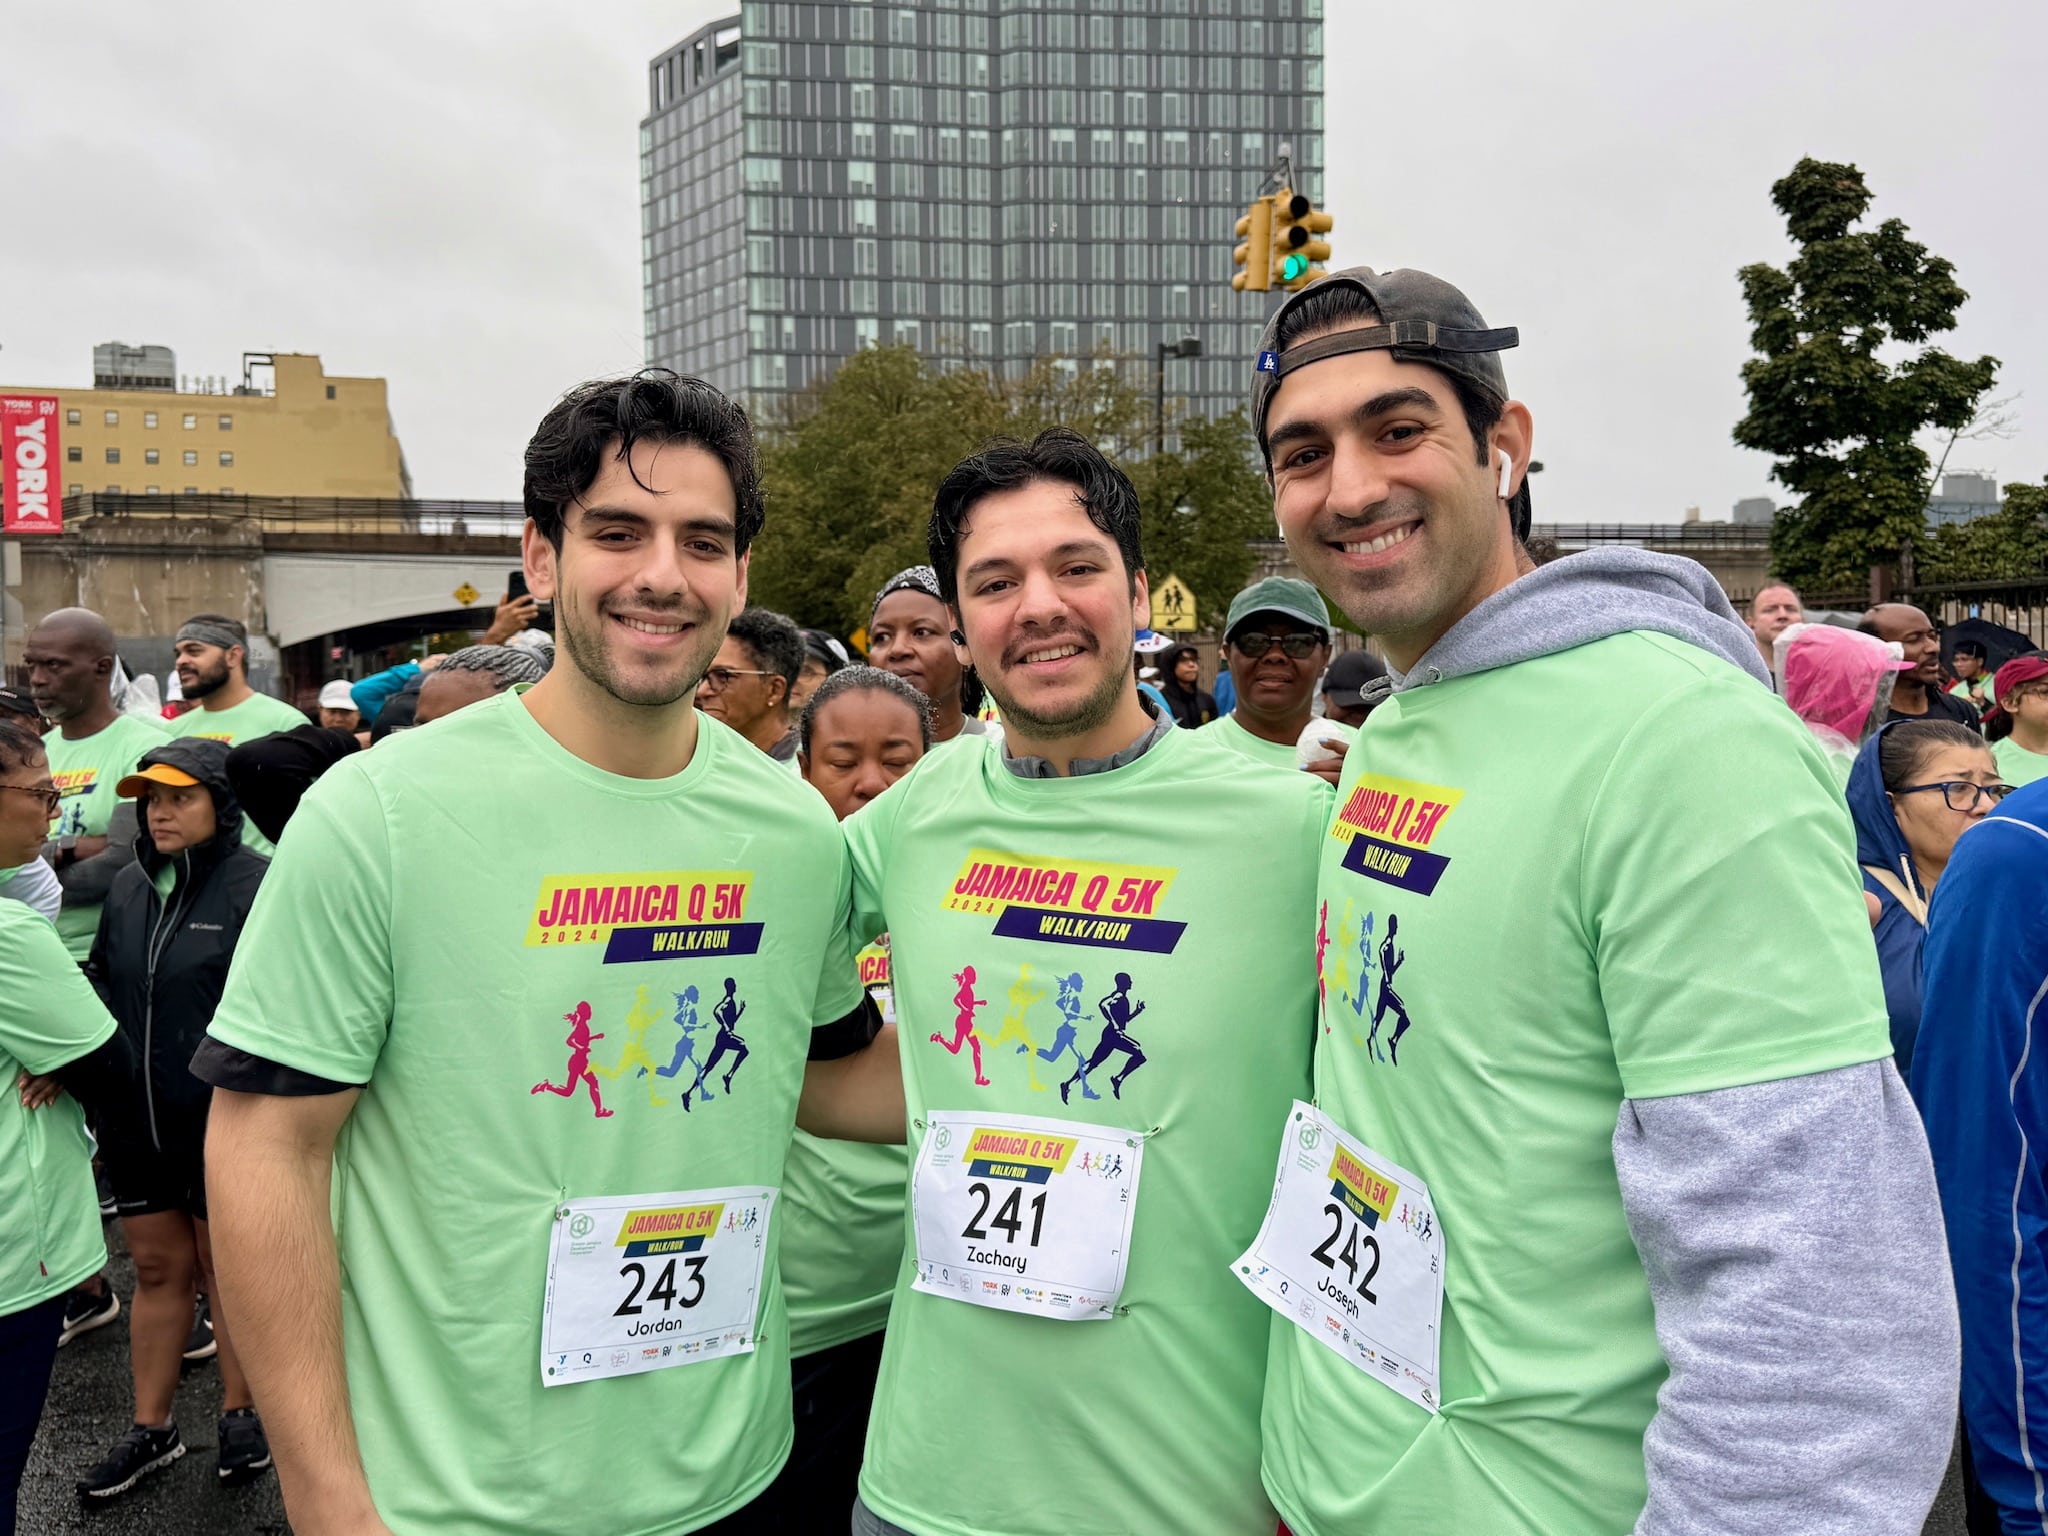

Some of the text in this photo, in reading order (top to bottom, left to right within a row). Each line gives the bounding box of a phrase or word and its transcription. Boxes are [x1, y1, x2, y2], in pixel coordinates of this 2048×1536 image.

[15, 416, 49, 519] YORK
[1340, 786, 1450, 845] JAMAICA Q 5K
[1363, 844, 1412, 878] WALK/RUN
[954, 862, 1163, 915] JAMAICA Q 5K
[538, 883, 746, 927] JAMAICA Q 5K
[950, 898, 994, 914] 2024
[541, 930, 597, 943] 2024
[652, 929, 730, 952] WALK/RUN
[1038, 915, 1131, 941] WALK/RUN
[857, 956, 888, 983] ICA
[973, 1134, 1065, 1161] JAMAICA Q 5K
[989, 1164, 1028, 1179] WALK/RUN
[1336, 1152, 1365, 1192] JAMAICA
[1365, 1176, 1372, 1196] Q
[1373, 1183, 1389, 1206] 5K
[628, 1210, 714, 1235] JAMAICA Q 5K
[961, 1182, 1047, 1247] 241
[647, 1240, 685, 1253] WALK/RUN
[967, 1245, 1027, 1274] Zachary
[1310, 1203, 1380, 1305] 242
[612, 1255, 709, 1317] 243
[982, 1281, 998, 1290] YORK
[1317, 1276, 1359, 1319] Joseph
[627, 1318, 682, 1337] Jordan
[642, 1347, 659, 1356] YORK
